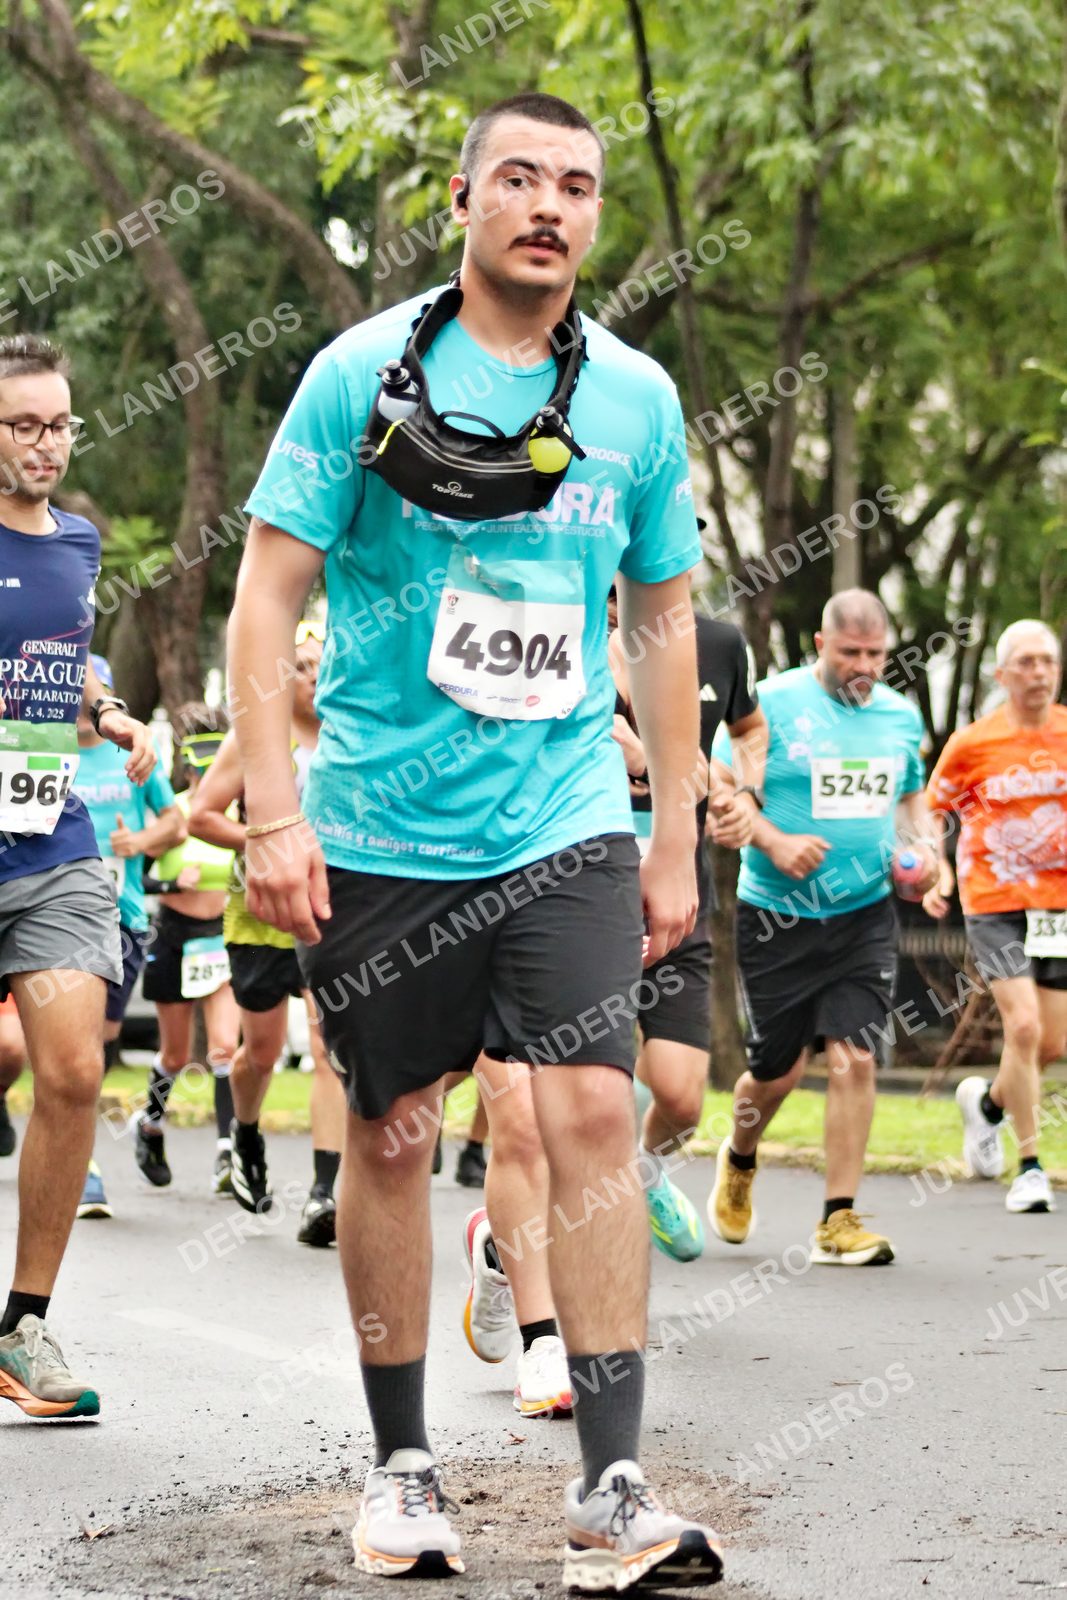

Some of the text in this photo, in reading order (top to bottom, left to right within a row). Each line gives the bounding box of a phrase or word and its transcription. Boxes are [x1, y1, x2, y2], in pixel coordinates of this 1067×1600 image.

[431, 483, 474, 499] TOPTIME
[22, 639, 78, 658] GENERALI
[445, 621, 571, 680] 4904
[438, 682, 478, 697] PERDURA
[820, 773, 888, 796] 5242
[356, 834, 365, 847] y
[367, 834, 414, 854] amigos
